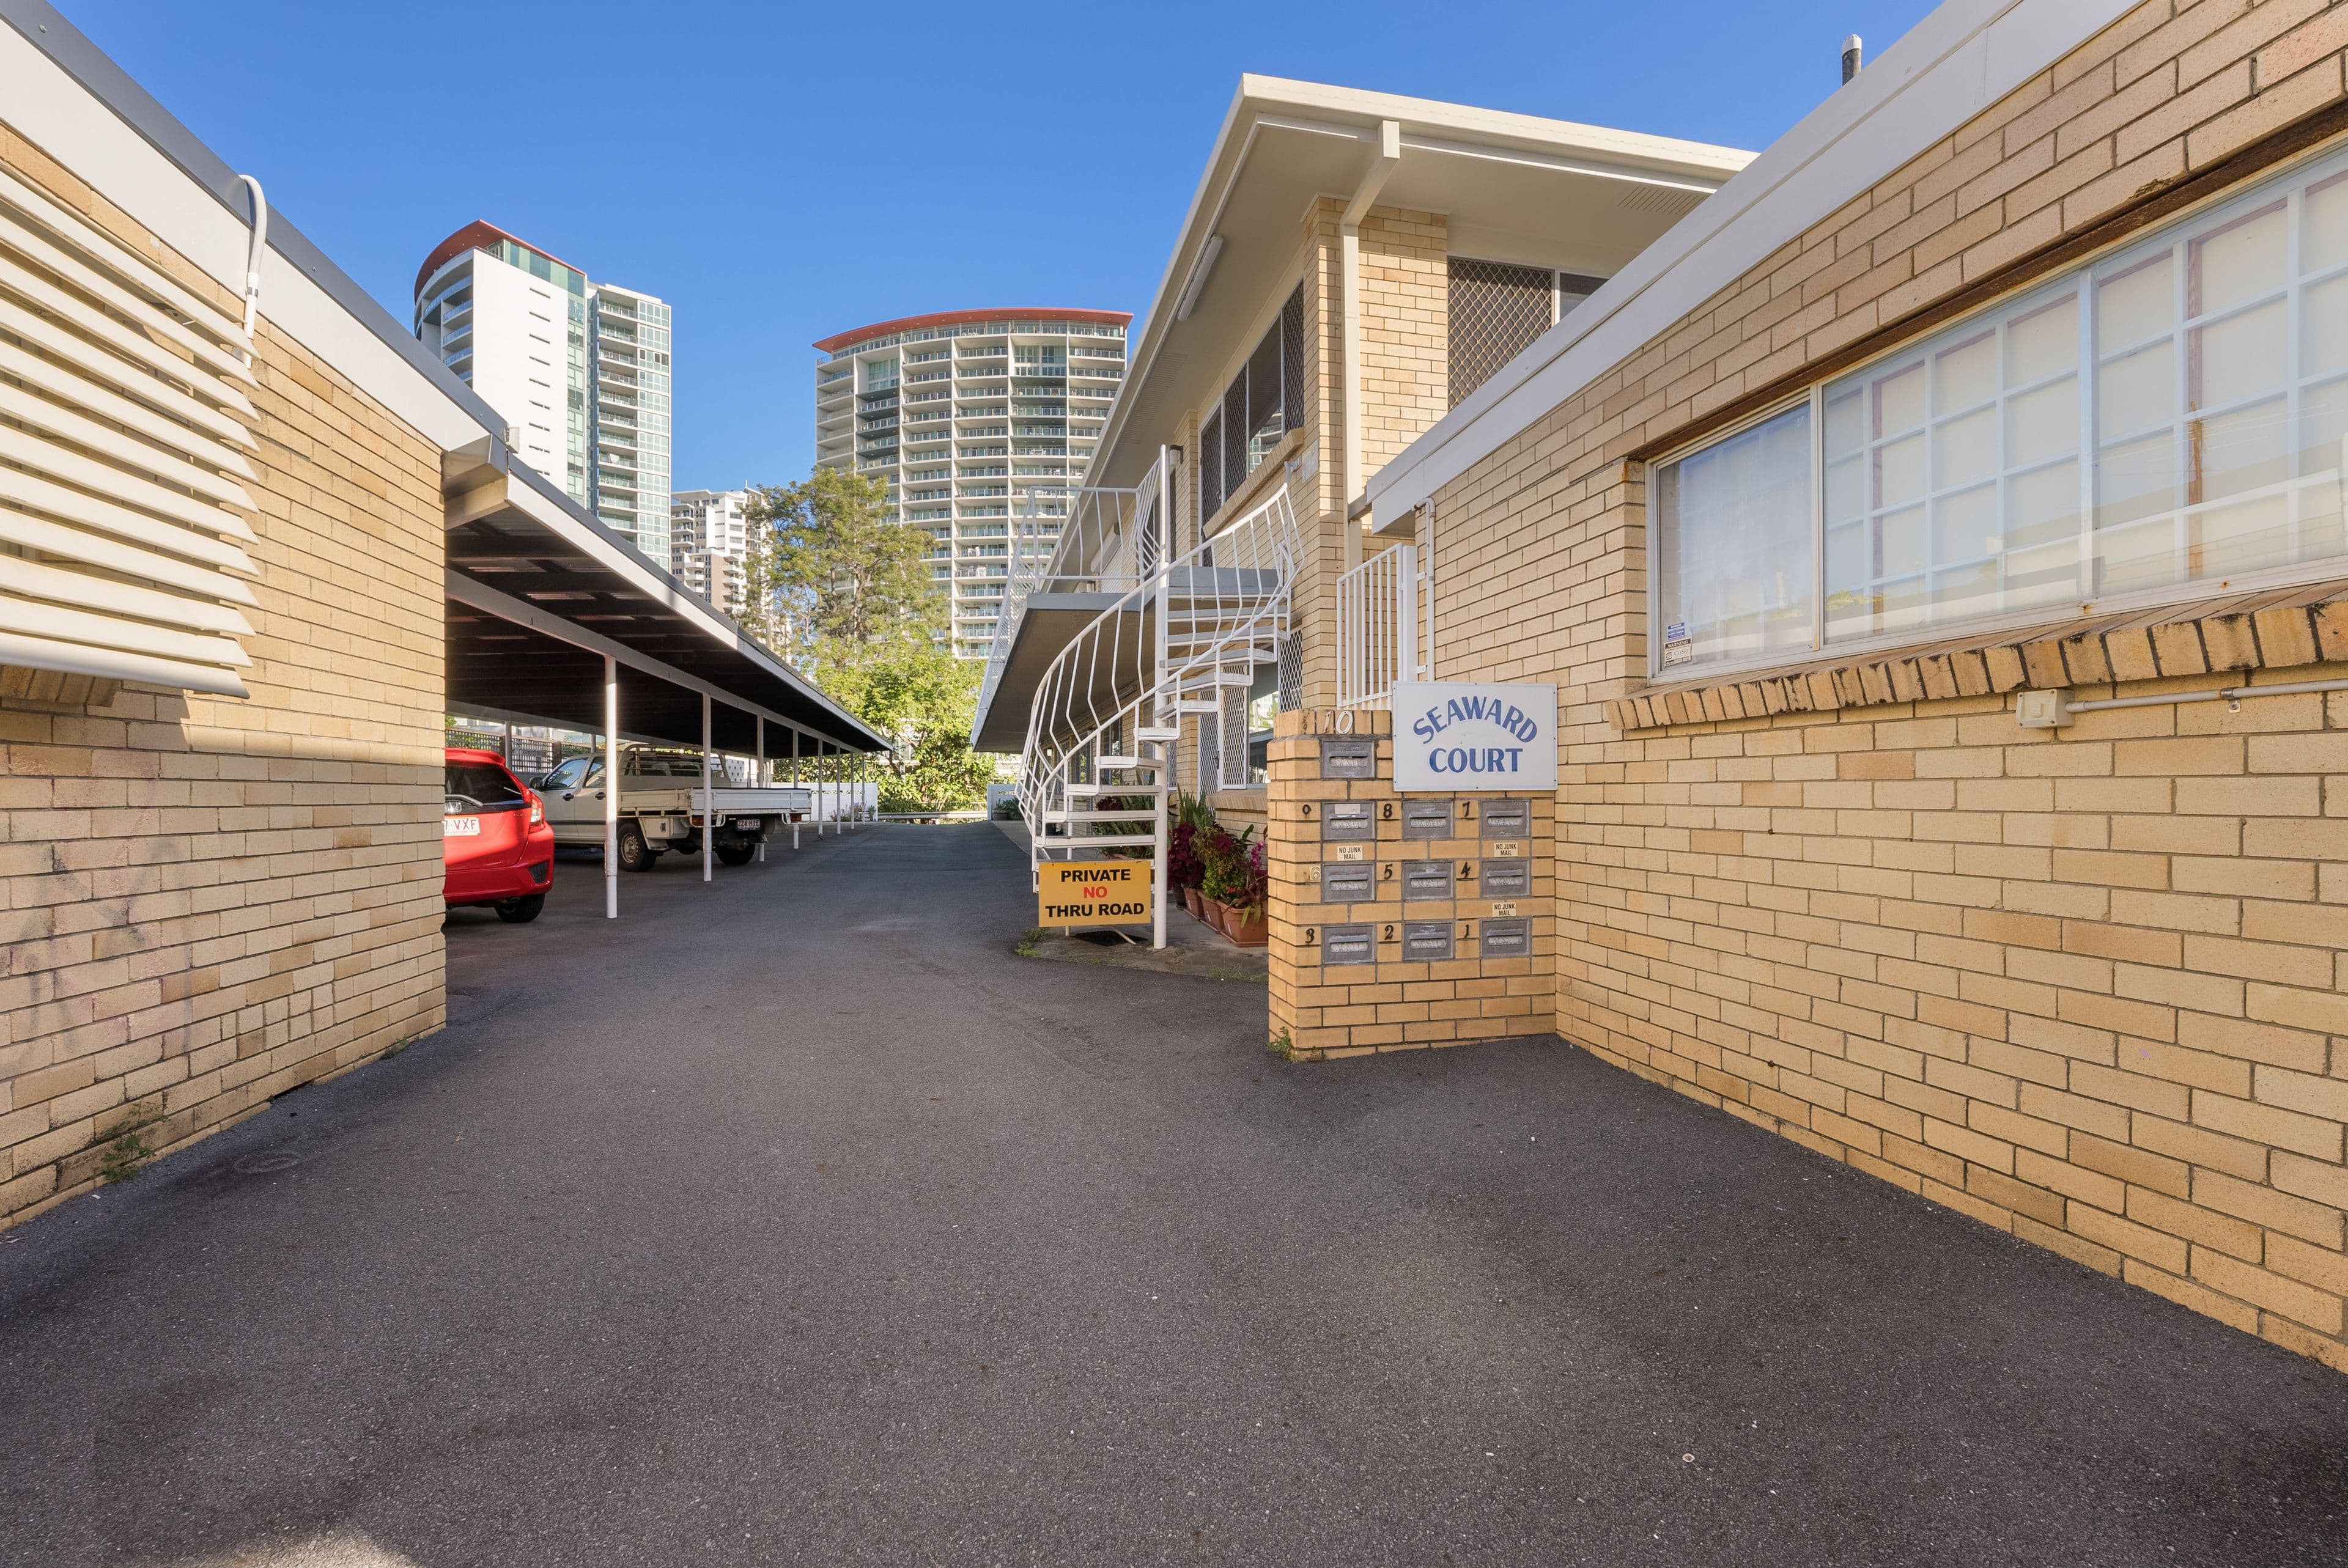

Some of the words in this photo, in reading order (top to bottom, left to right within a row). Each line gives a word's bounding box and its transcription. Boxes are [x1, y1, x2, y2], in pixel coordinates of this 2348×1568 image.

[1322, 710, 1353, 734] 10
[1413, 696, 1537, 744] SEAWARD
[1429, 748, 1523, 773] COURT
[1383, 803, 1392, 818] 8
[1462, 801, 1470, 817] 7
[1061, 869, 1131, 882] PRIVATE
[1310, 867, 1321, 880] 6
[1384, 863, 1393, 879] 5
[1461, 861, 1471, 878] 4
[1084, 886, 1107, 899] NO
[1046, 904, 1093, 918] THRU
[1098, 903, 1144, 916] ROAD
[1305, 928, 1315, 943] 3
[1384, 925, 1394, 940] 2
[1464, 924, 1469, 938] 1
